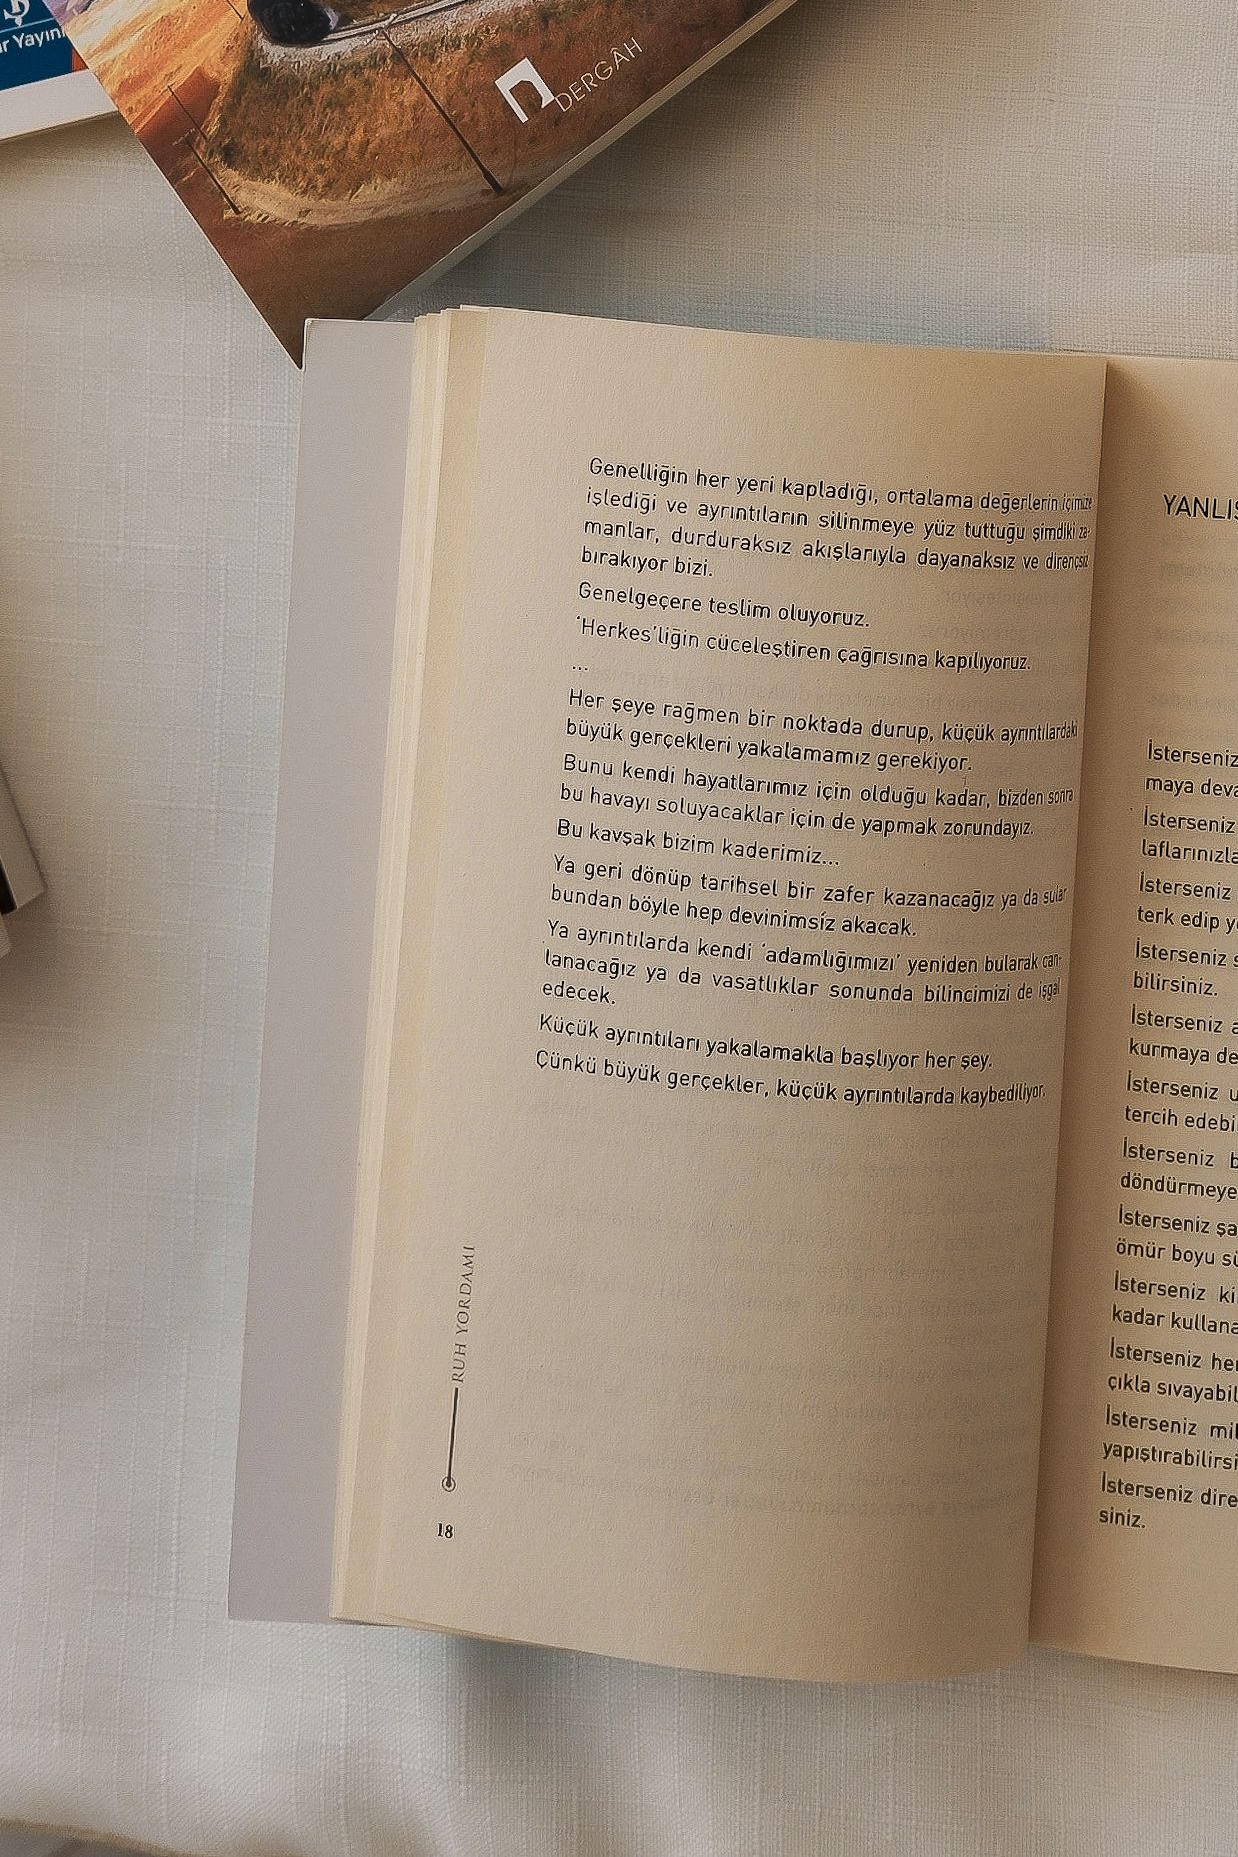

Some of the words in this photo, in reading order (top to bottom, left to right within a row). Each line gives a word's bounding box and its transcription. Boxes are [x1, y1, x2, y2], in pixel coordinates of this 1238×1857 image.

[554, 37, 643, 113] DERGÂH
[588, 456, 689, 489] Genelliğin
[693, 467, 732, 490] her
[735, 475, 777, 497] yeri
[781, 476, 879, 507] kapladığı,
[886, 487, 974, 510] ortalama
[975, 490, 1059, 516] değerlerin
[580, 543, 670, 575] bırakıyor
[671, 554, 714, 578] bizi.
[577, 579, 703, 613] Genelgeçere
[707, 596, 772, 620] teslim
[777, 602, 871, 629] oluyoruz.
[568, 686, 606, 710] Her
[610, 697, 657, 719] şeye
[662, 701, 740, 726] rağmen
[747, 706, 777, 729] bir
[781, 712, 864, 737] noktada
[867, 717, 935, 746] durup,
[940, 721, 996, 745] küçük
[565, 716, 625, 744] büyük
[628, 729, 734, 755] gerçekleri
[736, 737, 872, 767] yakalamamız
[875, 749, 973, 776] gerekiyor.
[1144, 776, 1195, 799] maya
[559, 781, 585, 803] bu
[589, 785, 651, 815] havayı
[655, 796, 786, 826] soluyacaklar
[789, 806, 826, 830] için
[828, 810, 857, 831] de
[859, 815, 939, 839] yapmak
[941, 817, 1032, 842] zorundayız.
[1142, 804, 1237, 835] İsterseniz
[554, 817, 584, 840] Bu
[588, 821, 657, 849] kavşak
[661, 829, 716, 855] bizim
[721, 836, 840, 867] kaderimiz...
[1138, 869, 1233, 902] İsterseniz
[1136, 904, 1177, 928] terk
[1179, 909, 1221, 935] edip
[541, 979, 617, 1006] edecek.
[538, 1012, 600, 1040] Küçük
[603, 1026, 701, 1053] ayrıntıları
[704, 1036, 835, 1065] yakalamakla
[839, 1045, 921, 1073] başlıyor
[924, 1048, 958, 1070] her
[959, 1053, 991, 1074] şey.
[535, 1048, 598, 1076] Çünkü
[602, 1057, 662, 1085] büyük
[666, 1070, 770, 1099] gerçekler,
[775, 1077, 839, 1102] küçük
[842, 1085, 956, 1108] ayrıntılarda
[959, 1082, 1045, 1110] kaybediliyor.
[1121, 1135, 1216, 1169] İsterseniz
[1119, 1170, 1238, 1205] döndürmeye
[1117, 1202, 1212, 1236] İsterseniz
[1115, 1240, 1168, 1261] ömür
[1170, 1242, 1216, 1269] boyu
[455, 1245, 476, 1335] YORDAMI
[451, 1342, 468, 1384] RUH
[1105, 1402, 1199, 1437] İsterseniz
[437, 1522, 454, 1539] 18
